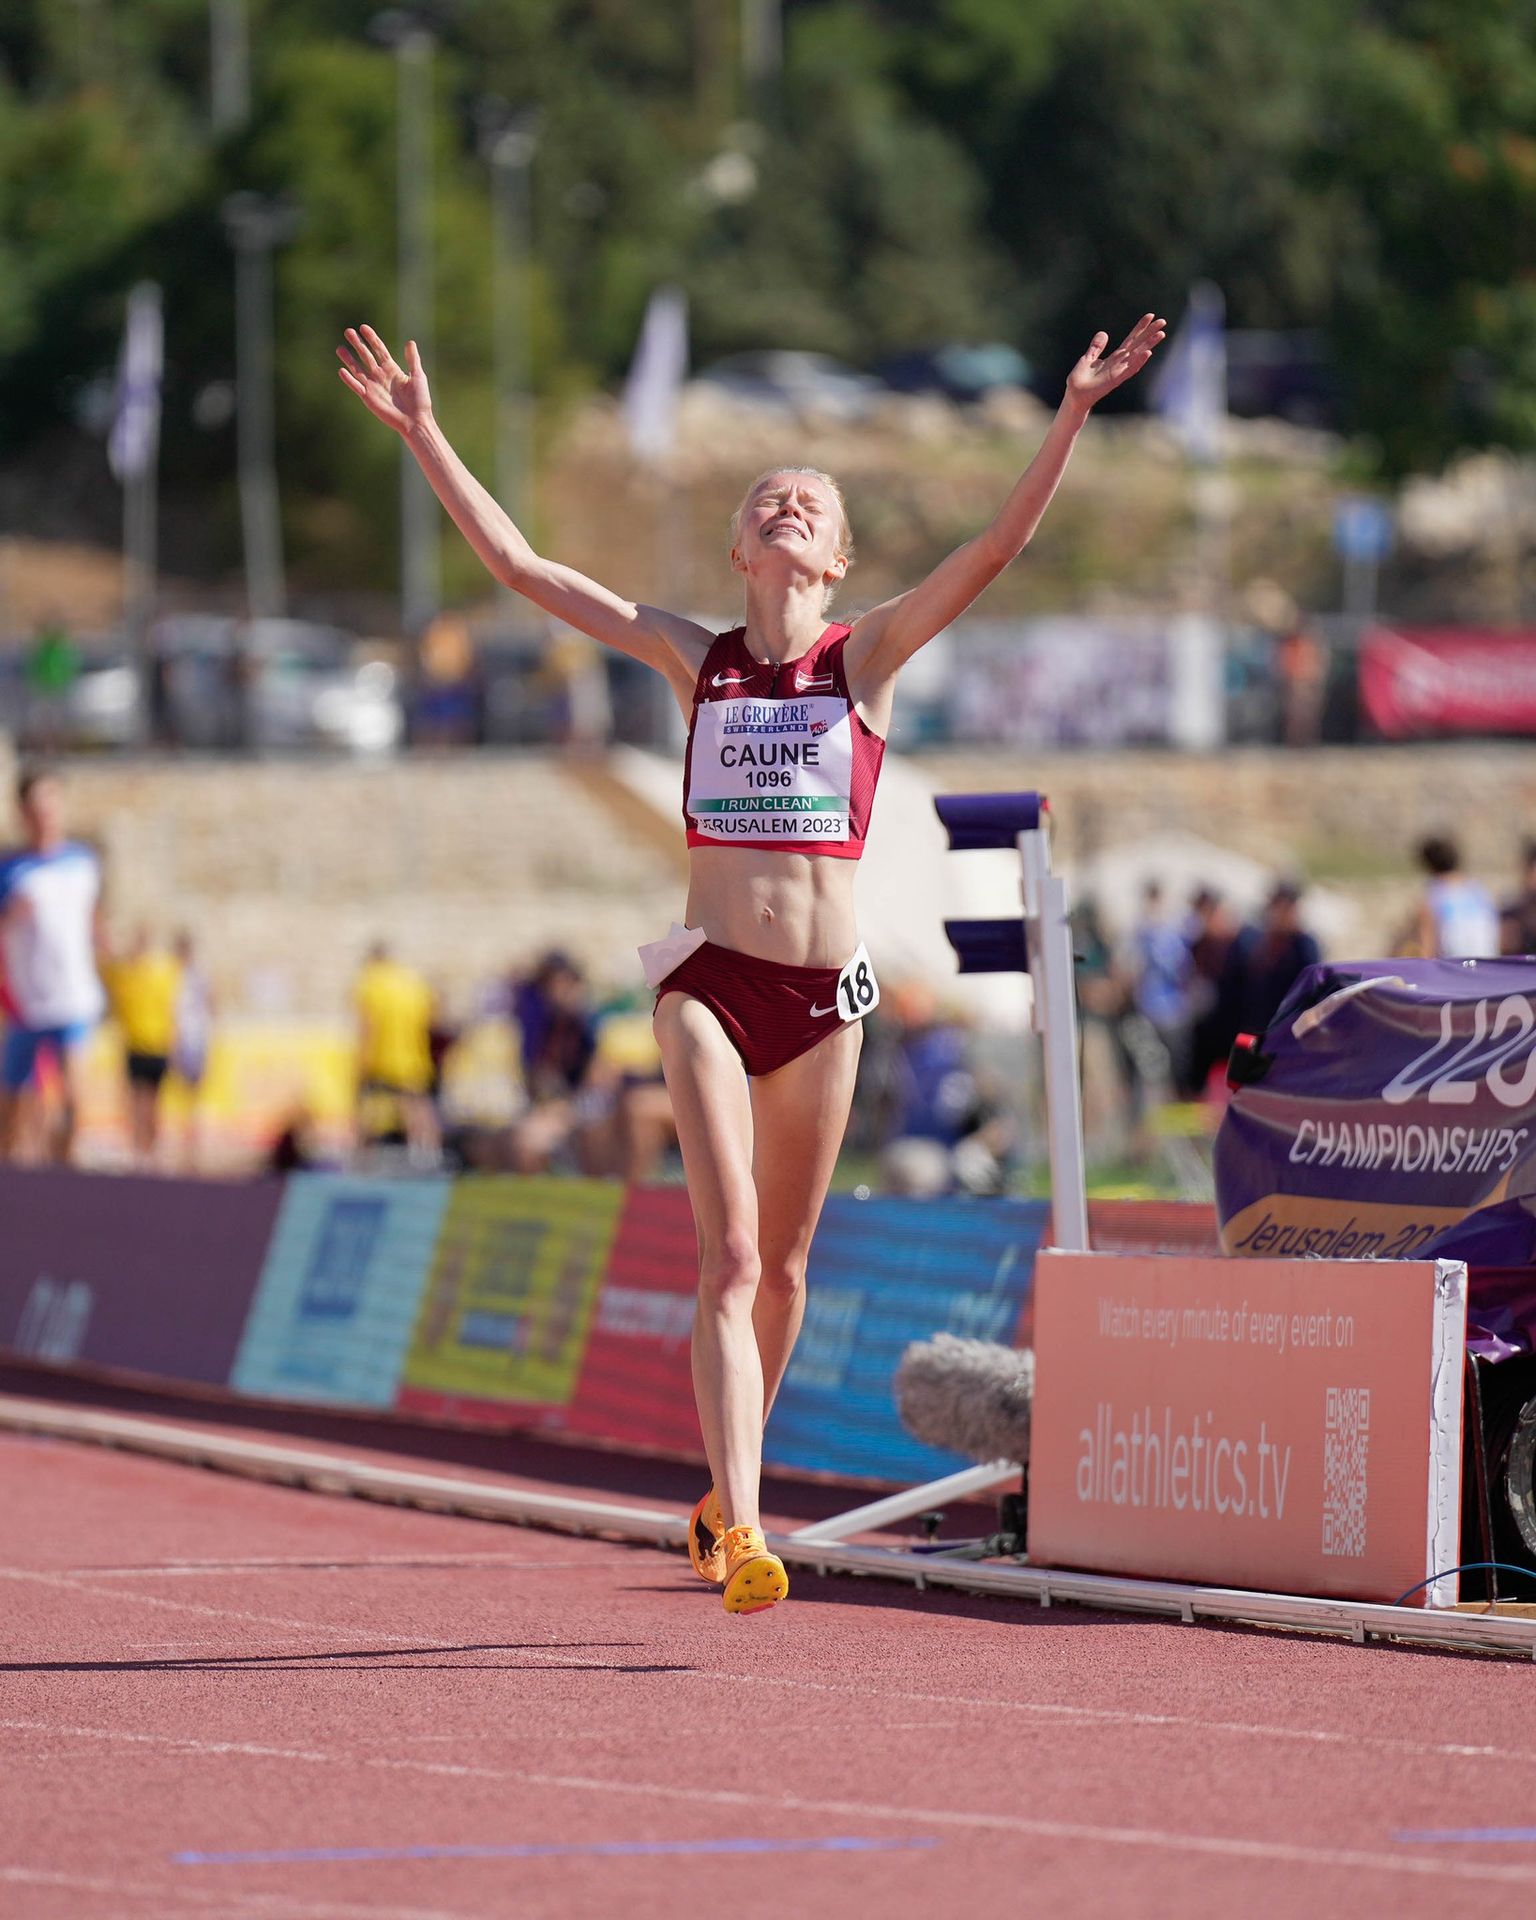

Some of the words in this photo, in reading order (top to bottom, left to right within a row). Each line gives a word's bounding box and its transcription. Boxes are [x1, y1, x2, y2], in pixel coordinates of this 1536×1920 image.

[725, 706, 739, 725] LE
[726, 724, 804, 734] SWITZERLAND
[720, 743, 820, 768] CAUNE
[745, 771, 792, 788] 1096
[721, 800, 726, 811] I
[728, 799, 760, 811] RUN
[802, 818, 841, 833] 2023
[839, 961, 874, 1014] 18
[1288, 1119, 1529, 1173] CHAMPIONSHIPS
[1235, 1213, 1385, 1258] Jerusalem
[1099, 1297, 1138, 1337] Watch
[1142, 1306, 1180, 1348] every
[1183, 1298, 1229, 1341] minute
[1232, 1300, 1249, 1342] of
[1250, 1312, 1288, 1354] every
[1291, 1308, 1333, 1347] event
[1335, 1314, 1355, 1347] on
[1076, 1402, 1292, 1520] allathletics.tv
